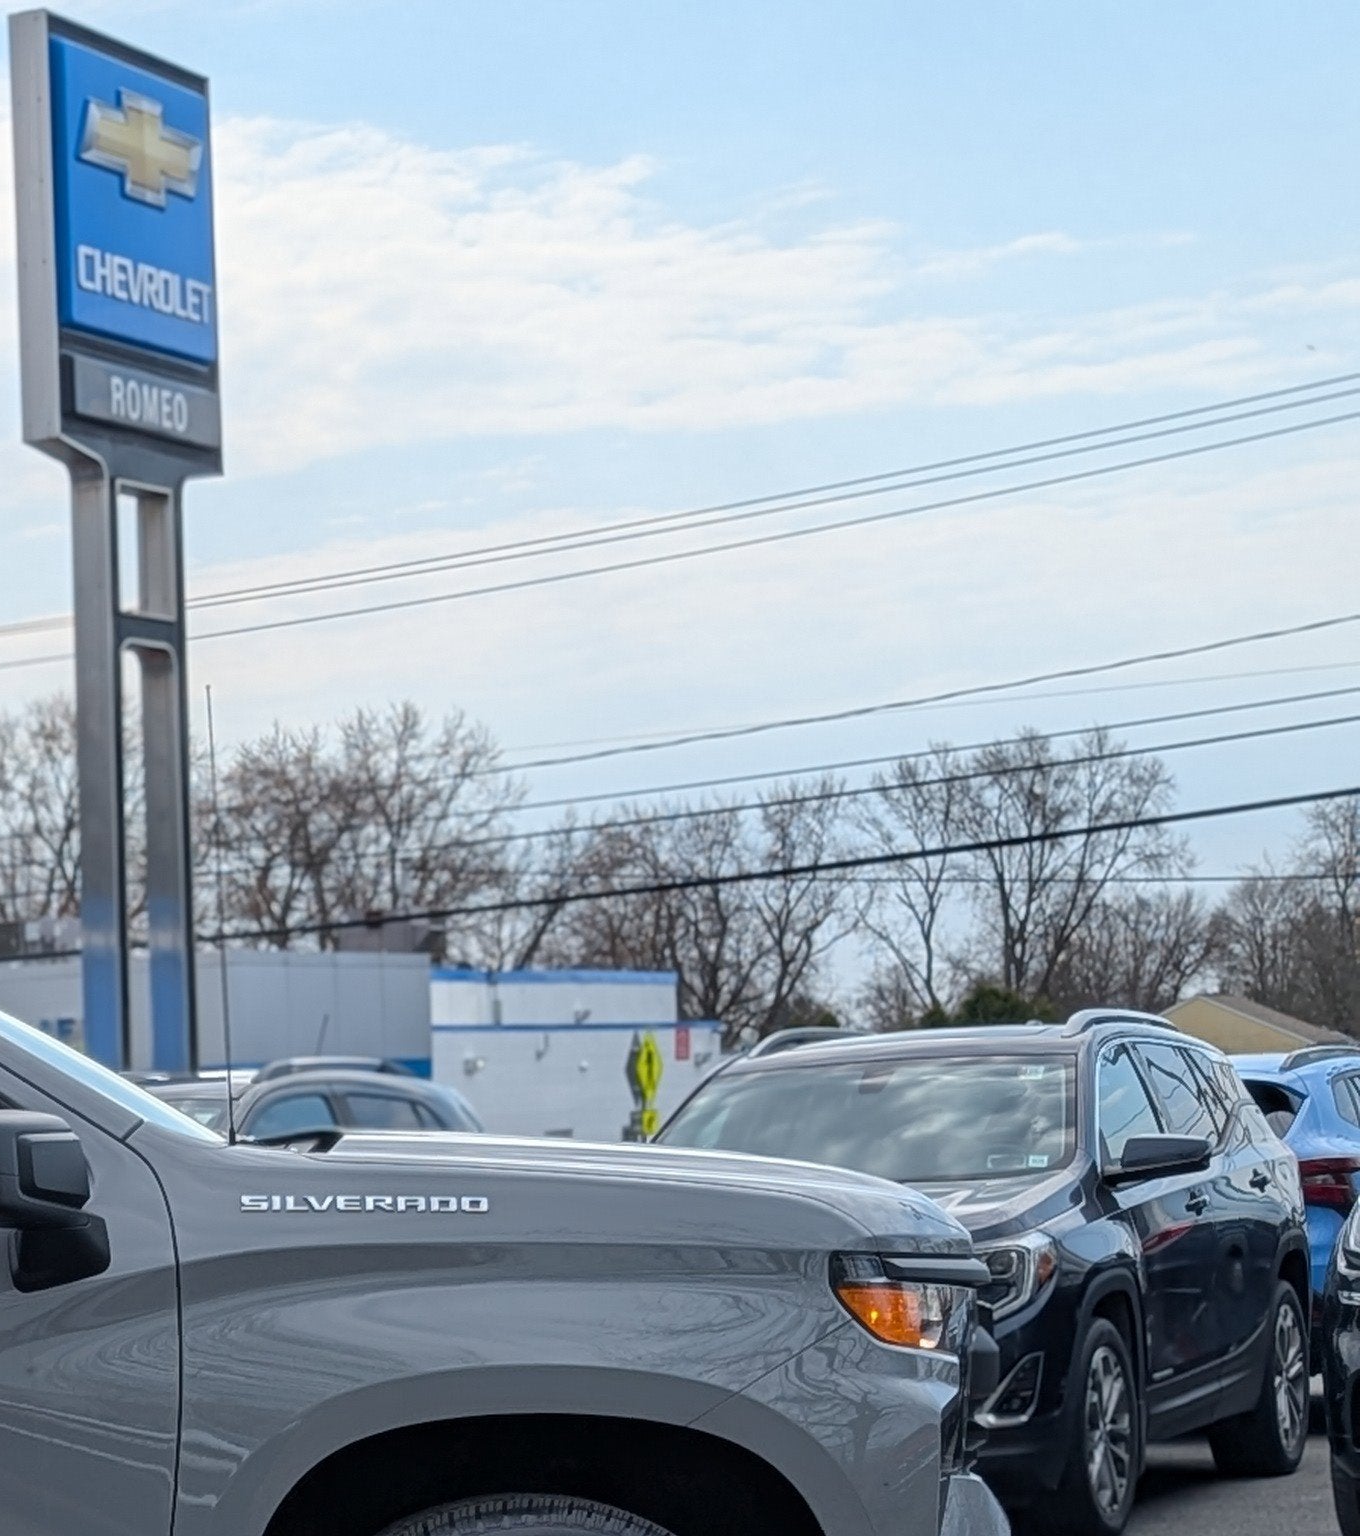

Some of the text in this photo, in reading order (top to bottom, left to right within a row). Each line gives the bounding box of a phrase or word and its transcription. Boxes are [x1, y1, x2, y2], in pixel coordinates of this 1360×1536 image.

[77, 244, 211, 324] CHEVROLET
[110, 376, 188, 432] ROMEO
[240, 1195, 490, 1213] SILVERADO
